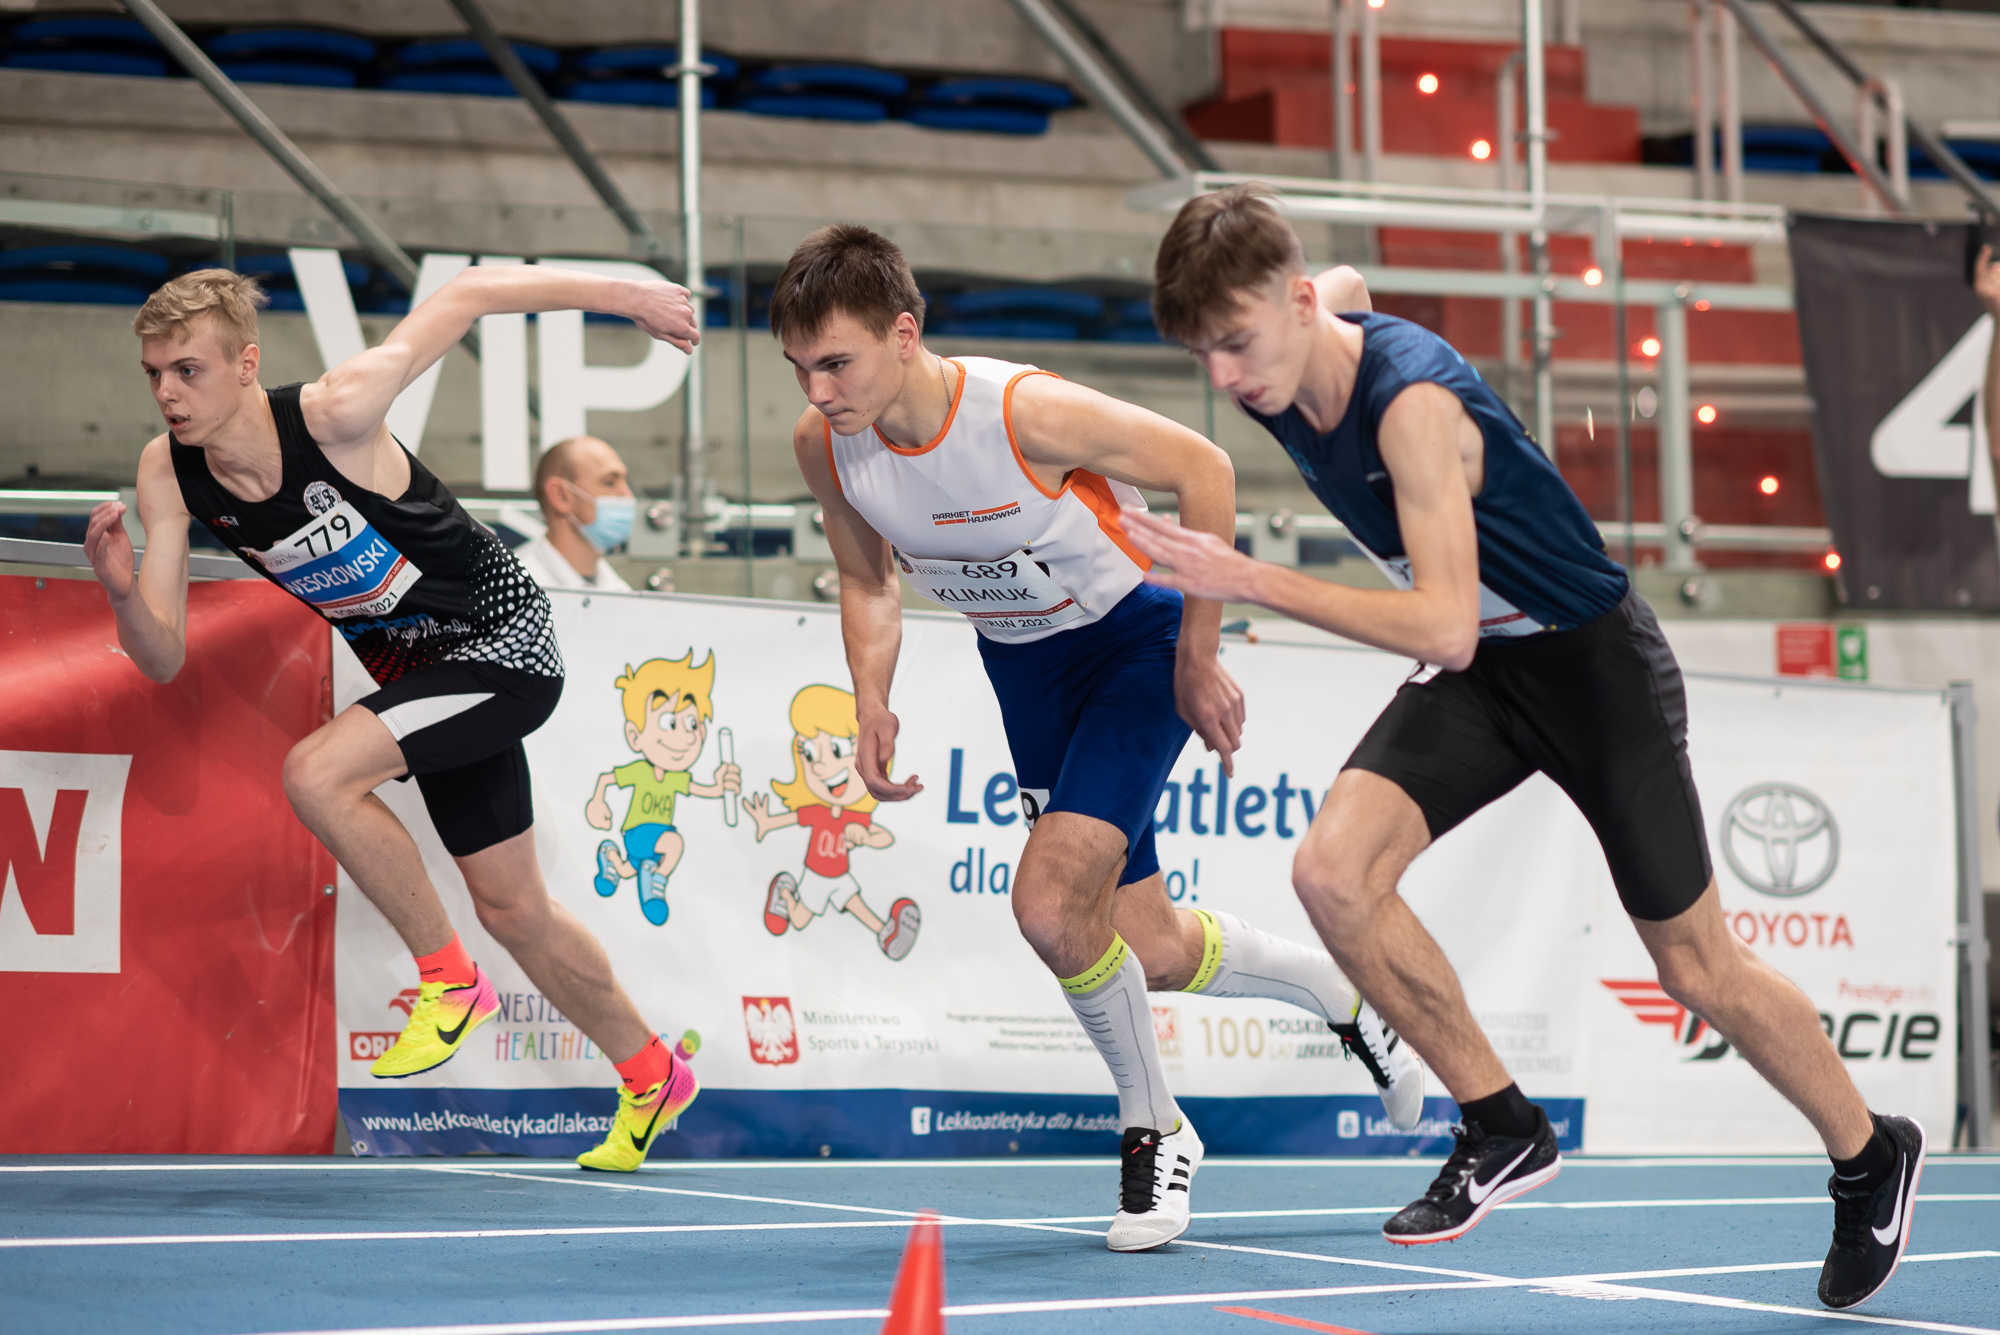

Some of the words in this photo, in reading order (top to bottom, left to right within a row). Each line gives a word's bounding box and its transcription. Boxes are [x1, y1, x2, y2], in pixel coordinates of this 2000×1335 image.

[288, 248, 692, 490] VIP
[932, 510, 970, 520] PARKIET
[294, 514, 351, 558] 779
[285, 538, 388, 595] WESOŁOWSKI
[915, 568, 956, 576] TORUŃ
[961, 560, 1018, 580] 689
[370, 591, 398, 613] 2021
[932, 587, 1038, 602] KLIMIUK
[980, 617, 1018, 629] RUŃ
[1018, 618, 1052, 629] 2021
[641, 791, 673, 818] OKA
[817, 829, 847, 858] OLA
[950, 847, 1010, 894] dla
[1723, 911, 1854, 948] OYOTA
[803, 1010, 901, 1026] Ministerstwo
[495, 1030, 605, 1062] HEALTHIE
[808, 1035, 860, 1054] Sportu
[874, 1035, 940, 1055] Turystyki
[1200, 1017, 1265, 1058] 100
[936, 1111, 1045, 1133] Lekkoatletyka
[1046, 1112, 1072, 1129] dla
